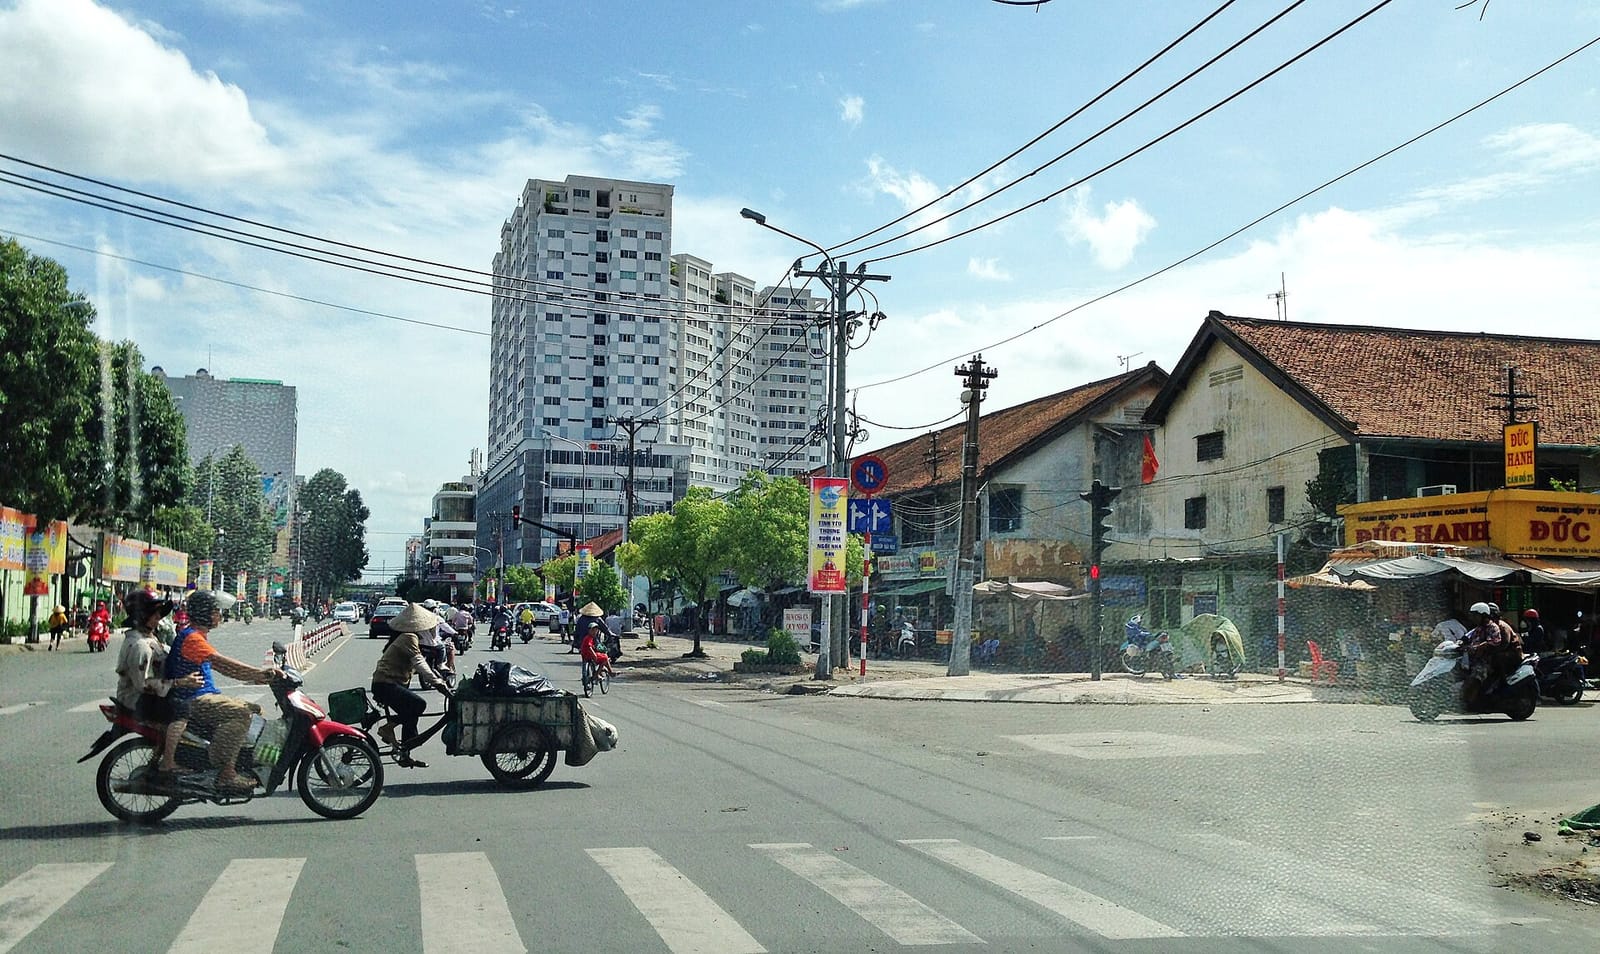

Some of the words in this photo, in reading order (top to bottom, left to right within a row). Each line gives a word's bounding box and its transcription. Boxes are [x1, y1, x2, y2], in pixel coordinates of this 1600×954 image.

[1510, 429, 1529, 447] ĐỨC
[1507, 451, 1533, 468] HẠNH
[1529, 515, 1591, 542] ĐỨC
